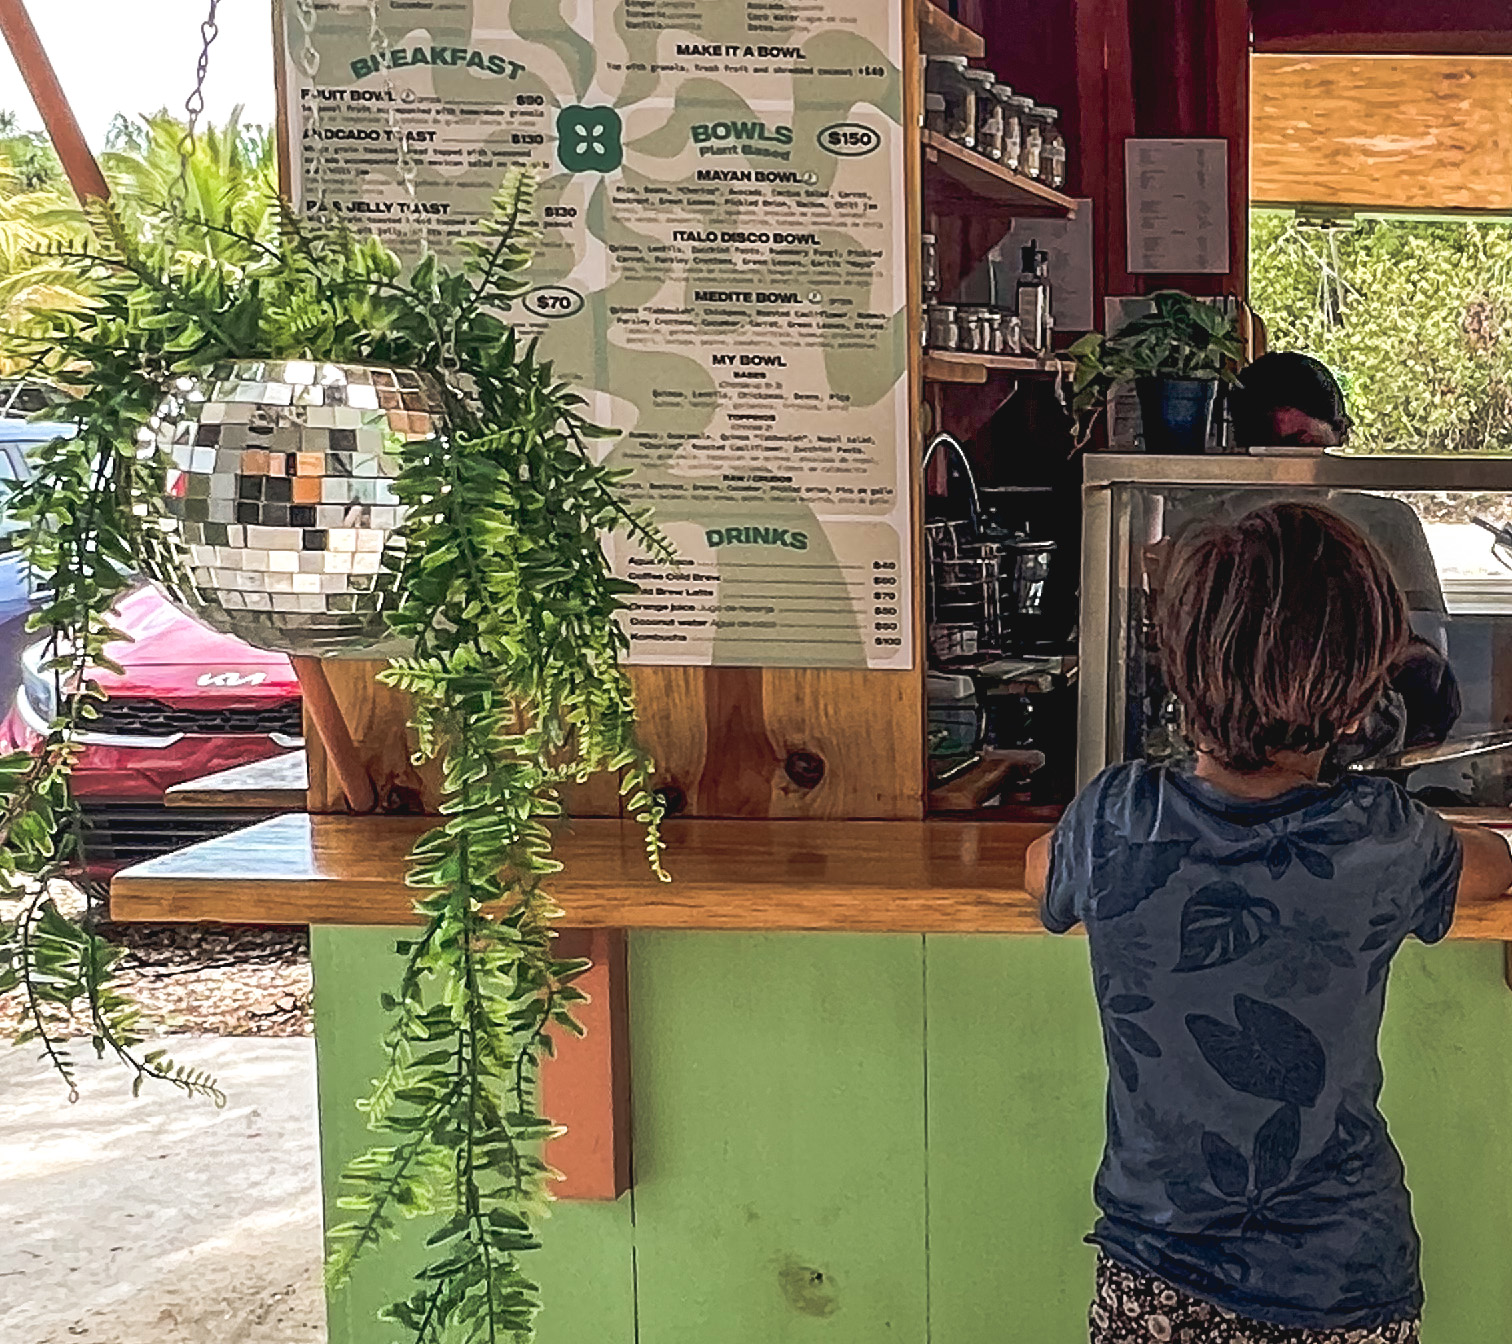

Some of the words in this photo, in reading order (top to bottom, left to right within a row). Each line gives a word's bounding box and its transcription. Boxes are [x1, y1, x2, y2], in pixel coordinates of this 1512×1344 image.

[675, 44, 722, 57] MAKE
[724, 44, 741, 57] IT
[742, 45, 754, 58] A
[756, 46, 807, 60] BOWL
[300, 88, 348, 102] FUIT
[382, 130, 438, 143] TAST
[690, 121, 794, 146] BOWLS
[827, 130, 872, 146] $150
[696, 169, 752, 183] MAYAN
[754, 170, 805, 185] BOWL
[345, 200, 394, 214] JELLY
[672, 230, 719, 243] ITALO
[720, 231, 770, 245] DISCO
[772, 233, 822, 247] BOWL
[536, 293, 572, 310] $70
[694, 290, 754, 304] MEDITE
[756, 291, 804, 305] BOWL
[711, 354, 736, 366] MY
[739, 354, 788, 368] BOWL
[705, 526, 809, 551] DRINKS
